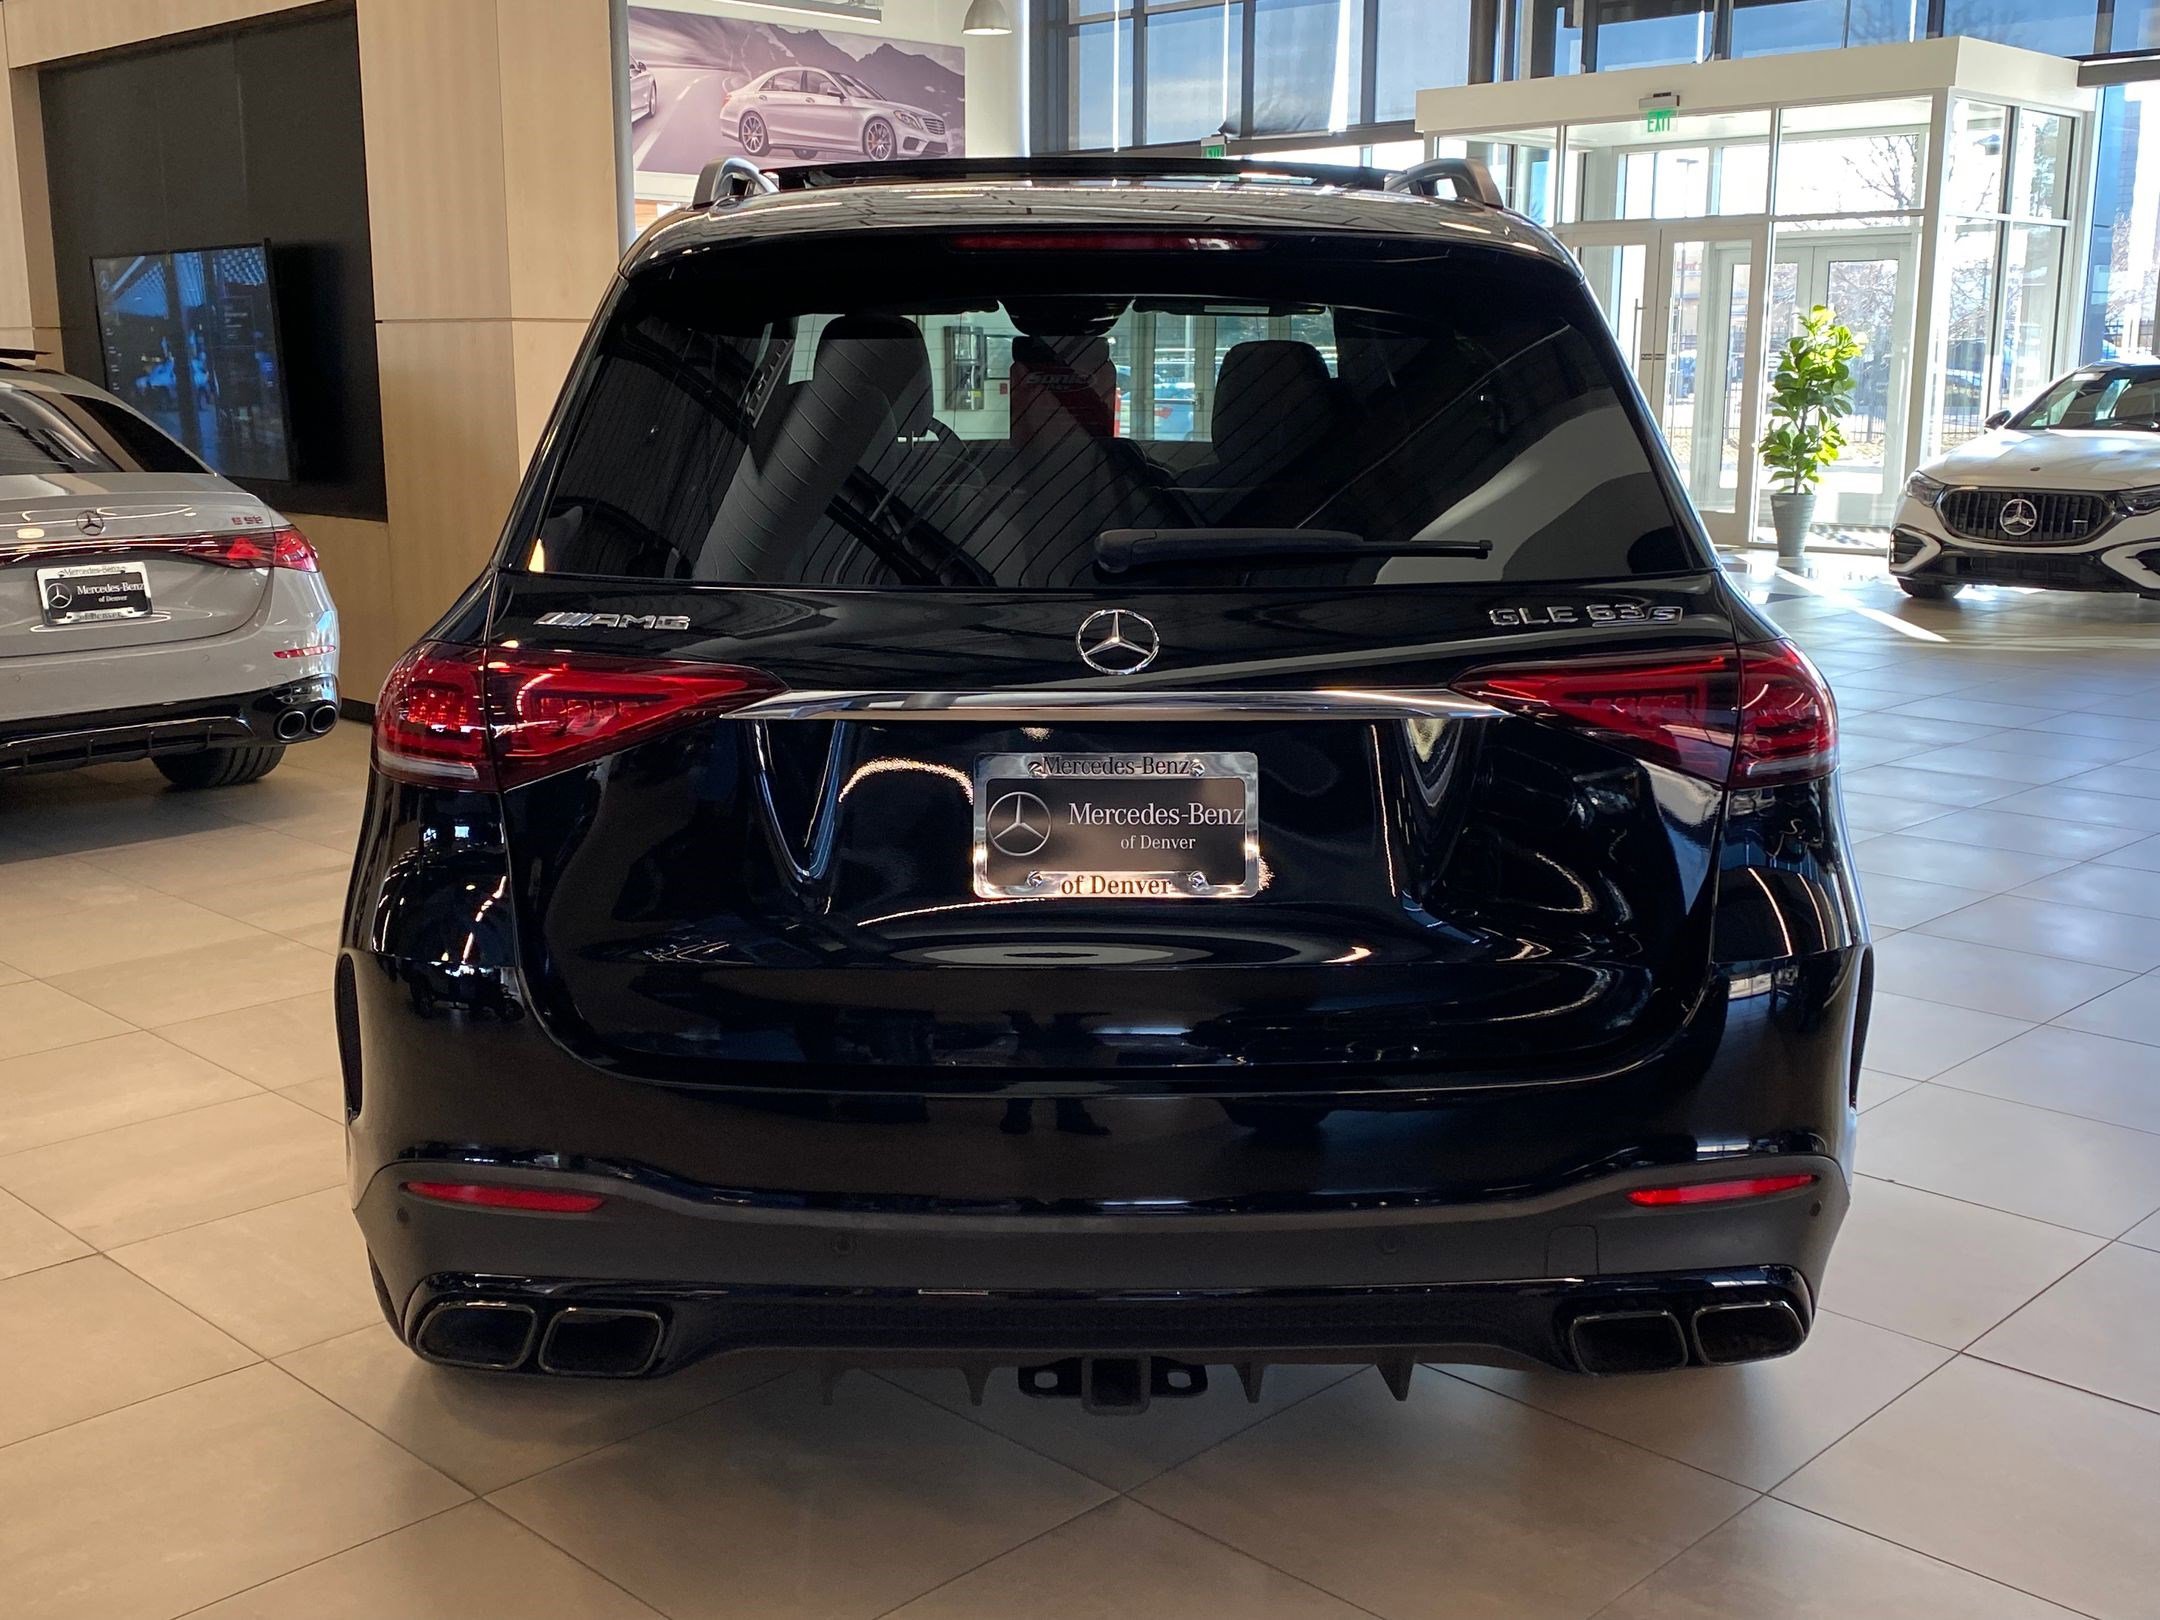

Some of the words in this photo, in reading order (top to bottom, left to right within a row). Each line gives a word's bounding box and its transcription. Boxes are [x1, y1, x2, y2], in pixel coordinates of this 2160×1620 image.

[1647, 116, 1671, 132] EXIT
[64, 566, 121, 576] Mercedes-Benz
[77, 582, 144, 595] Mercedes-Benz
[580, 613, 691, 631] AMG
[1489, 606, 1579, 626] GLE
[1586, 604, 1645, 621] 63
[1043, 756, 1191, 775] Mercedes-Benz
[1068, 802, 1246, 825] Mercedes-Benz
[1120, 834, 1135, 849] of
[1140, 835, 1196, 849] Denver
[1061, 877, 1086, 894] of
[1091, 876, 1172, 895] Denver
